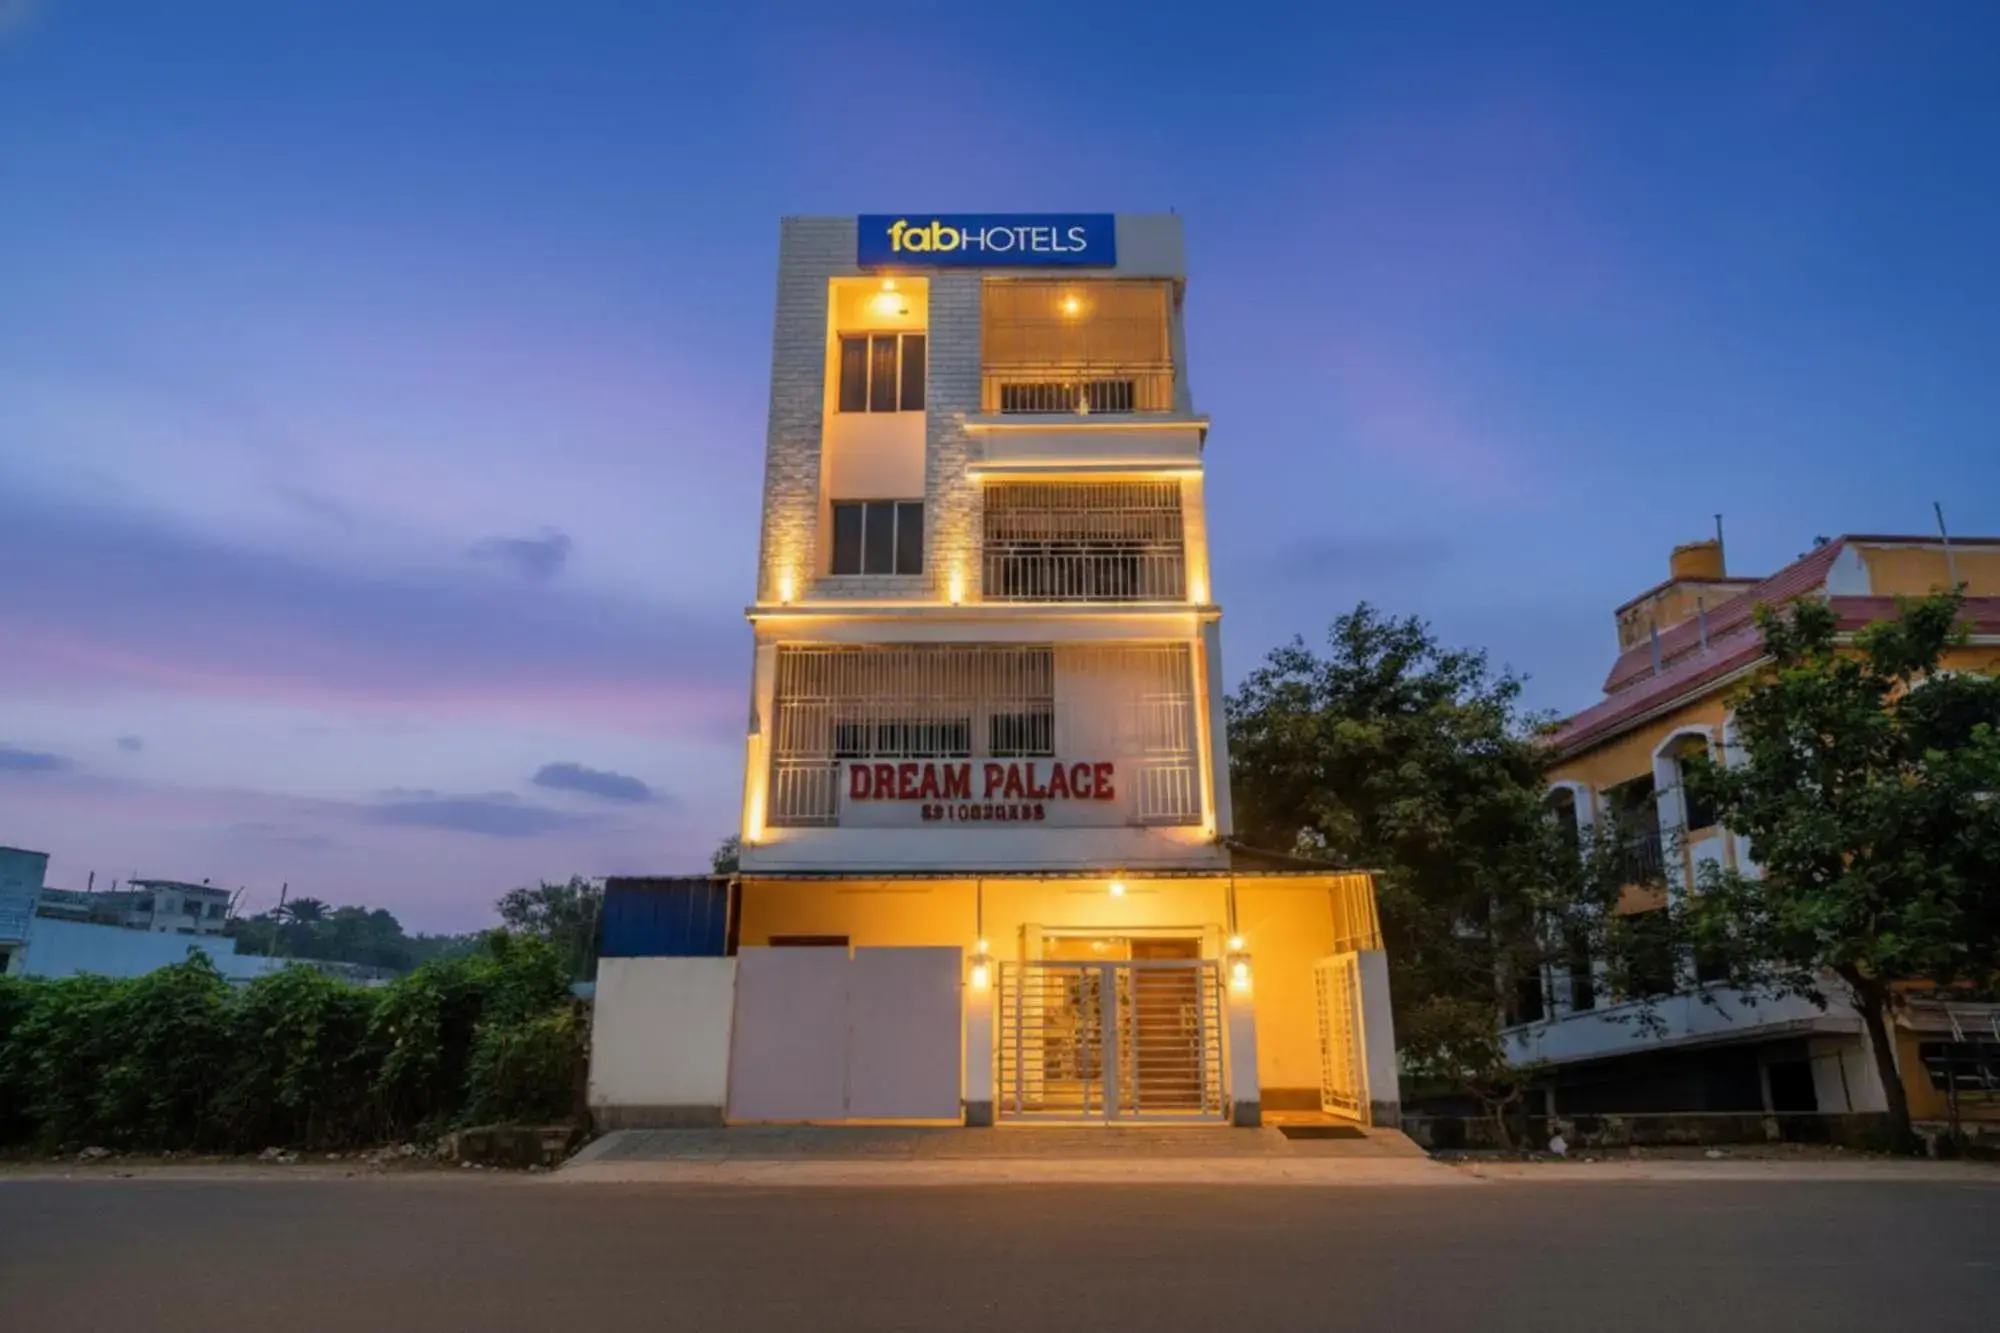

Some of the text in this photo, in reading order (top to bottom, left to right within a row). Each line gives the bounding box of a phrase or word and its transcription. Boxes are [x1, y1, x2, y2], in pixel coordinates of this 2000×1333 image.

[887, 219, 1087, 252] fabHOTELS
[850, 762, 1115, 801] DREAM PALACE
